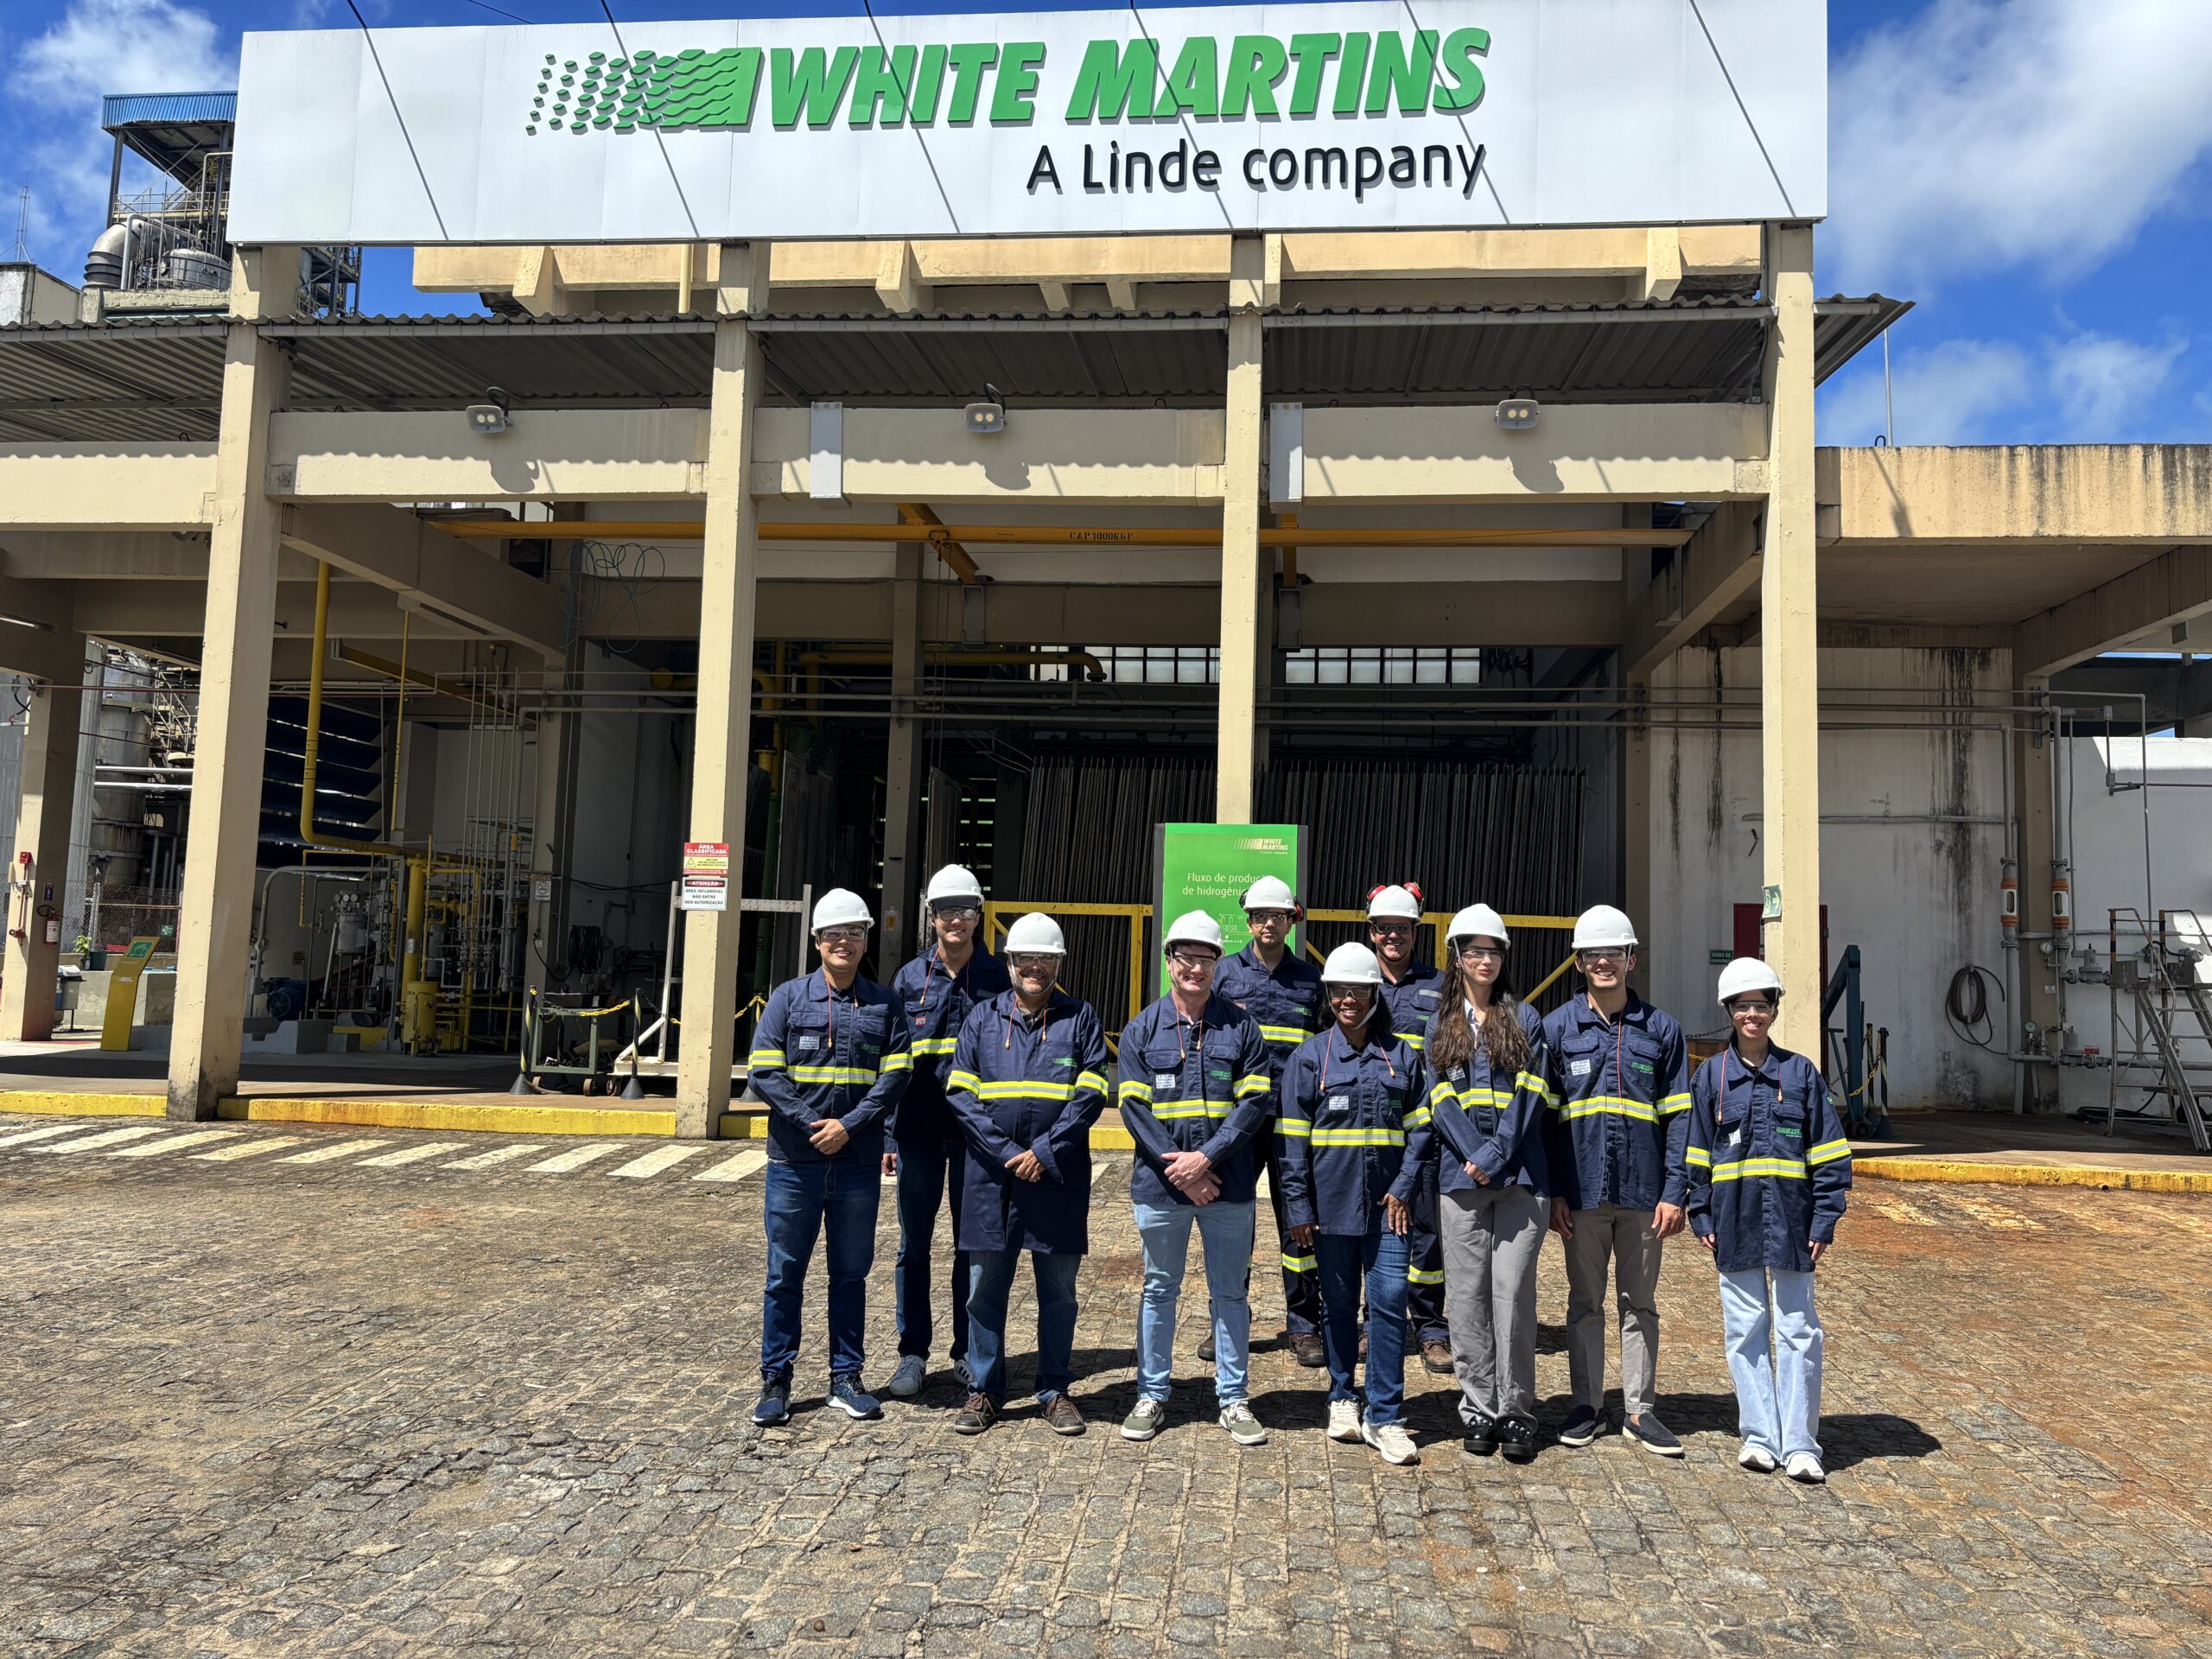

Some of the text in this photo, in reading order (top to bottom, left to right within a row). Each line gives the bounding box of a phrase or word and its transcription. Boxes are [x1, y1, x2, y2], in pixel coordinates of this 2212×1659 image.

[770, 27, 1490, 126] WHITE MARTINS
[1027, 138, 1484, 198] A Linde company
[1182, 886, 1194, 895] de
[1187, 873, 1265, 884] Fluxo de produç
